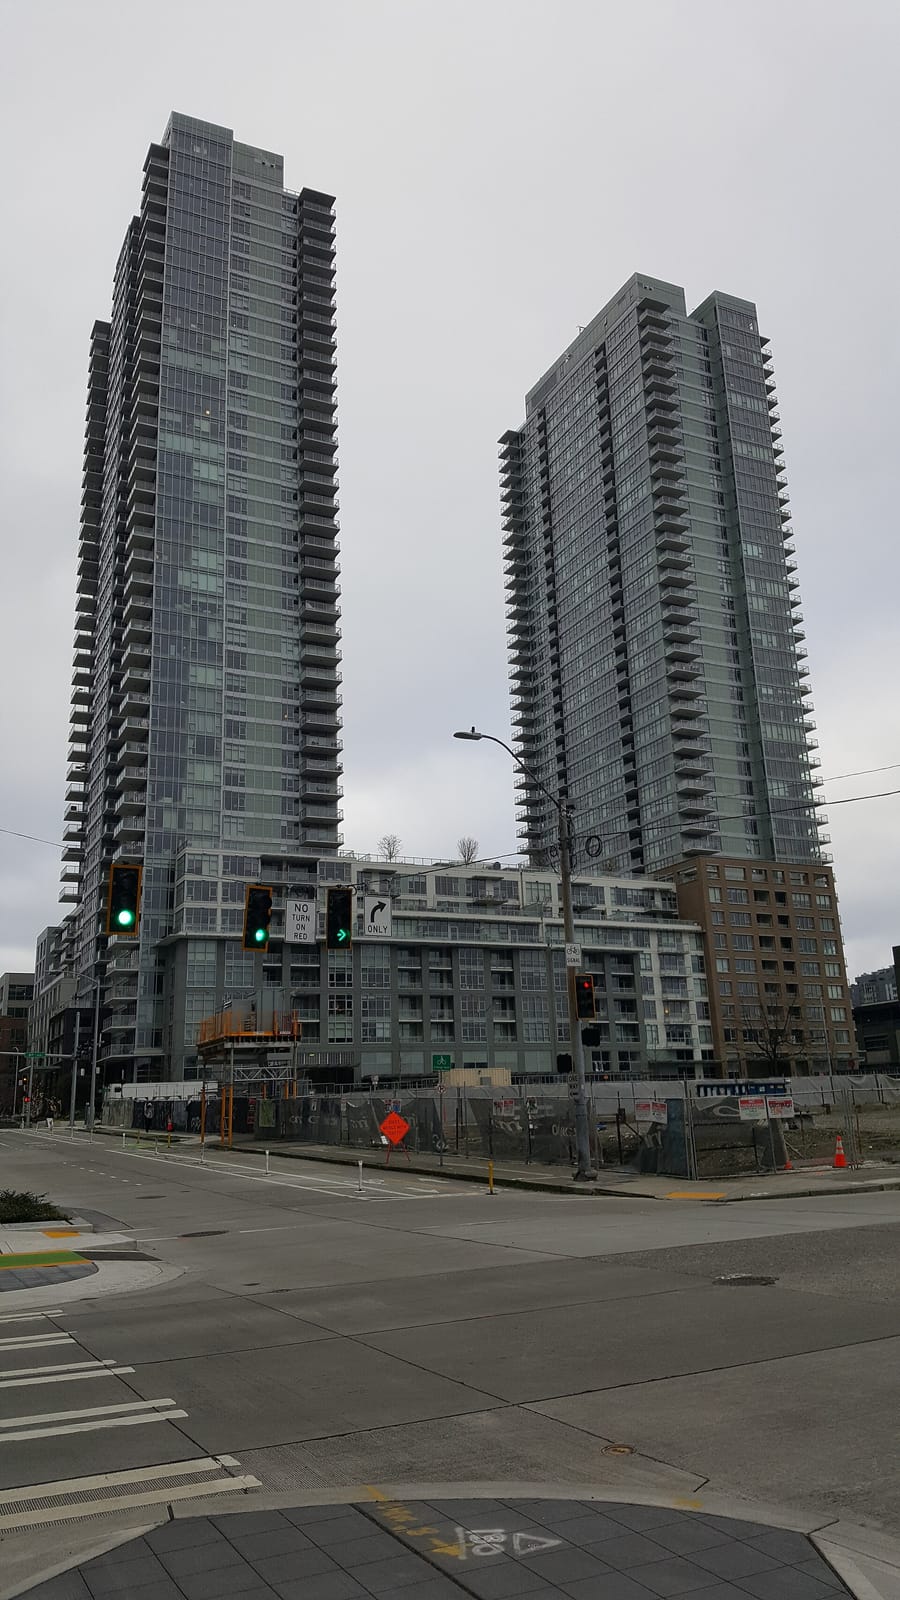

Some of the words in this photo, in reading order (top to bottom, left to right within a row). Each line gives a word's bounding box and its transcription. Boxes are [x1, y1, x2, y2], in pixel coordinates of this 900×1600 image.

[294, 903, 309, 913] NO
[292, 914, 310, 922] TURN
[295, 923, 306, 931] ON
[367, 925, 388, 934] ONLY
[293, 932, 308, 940] RED
